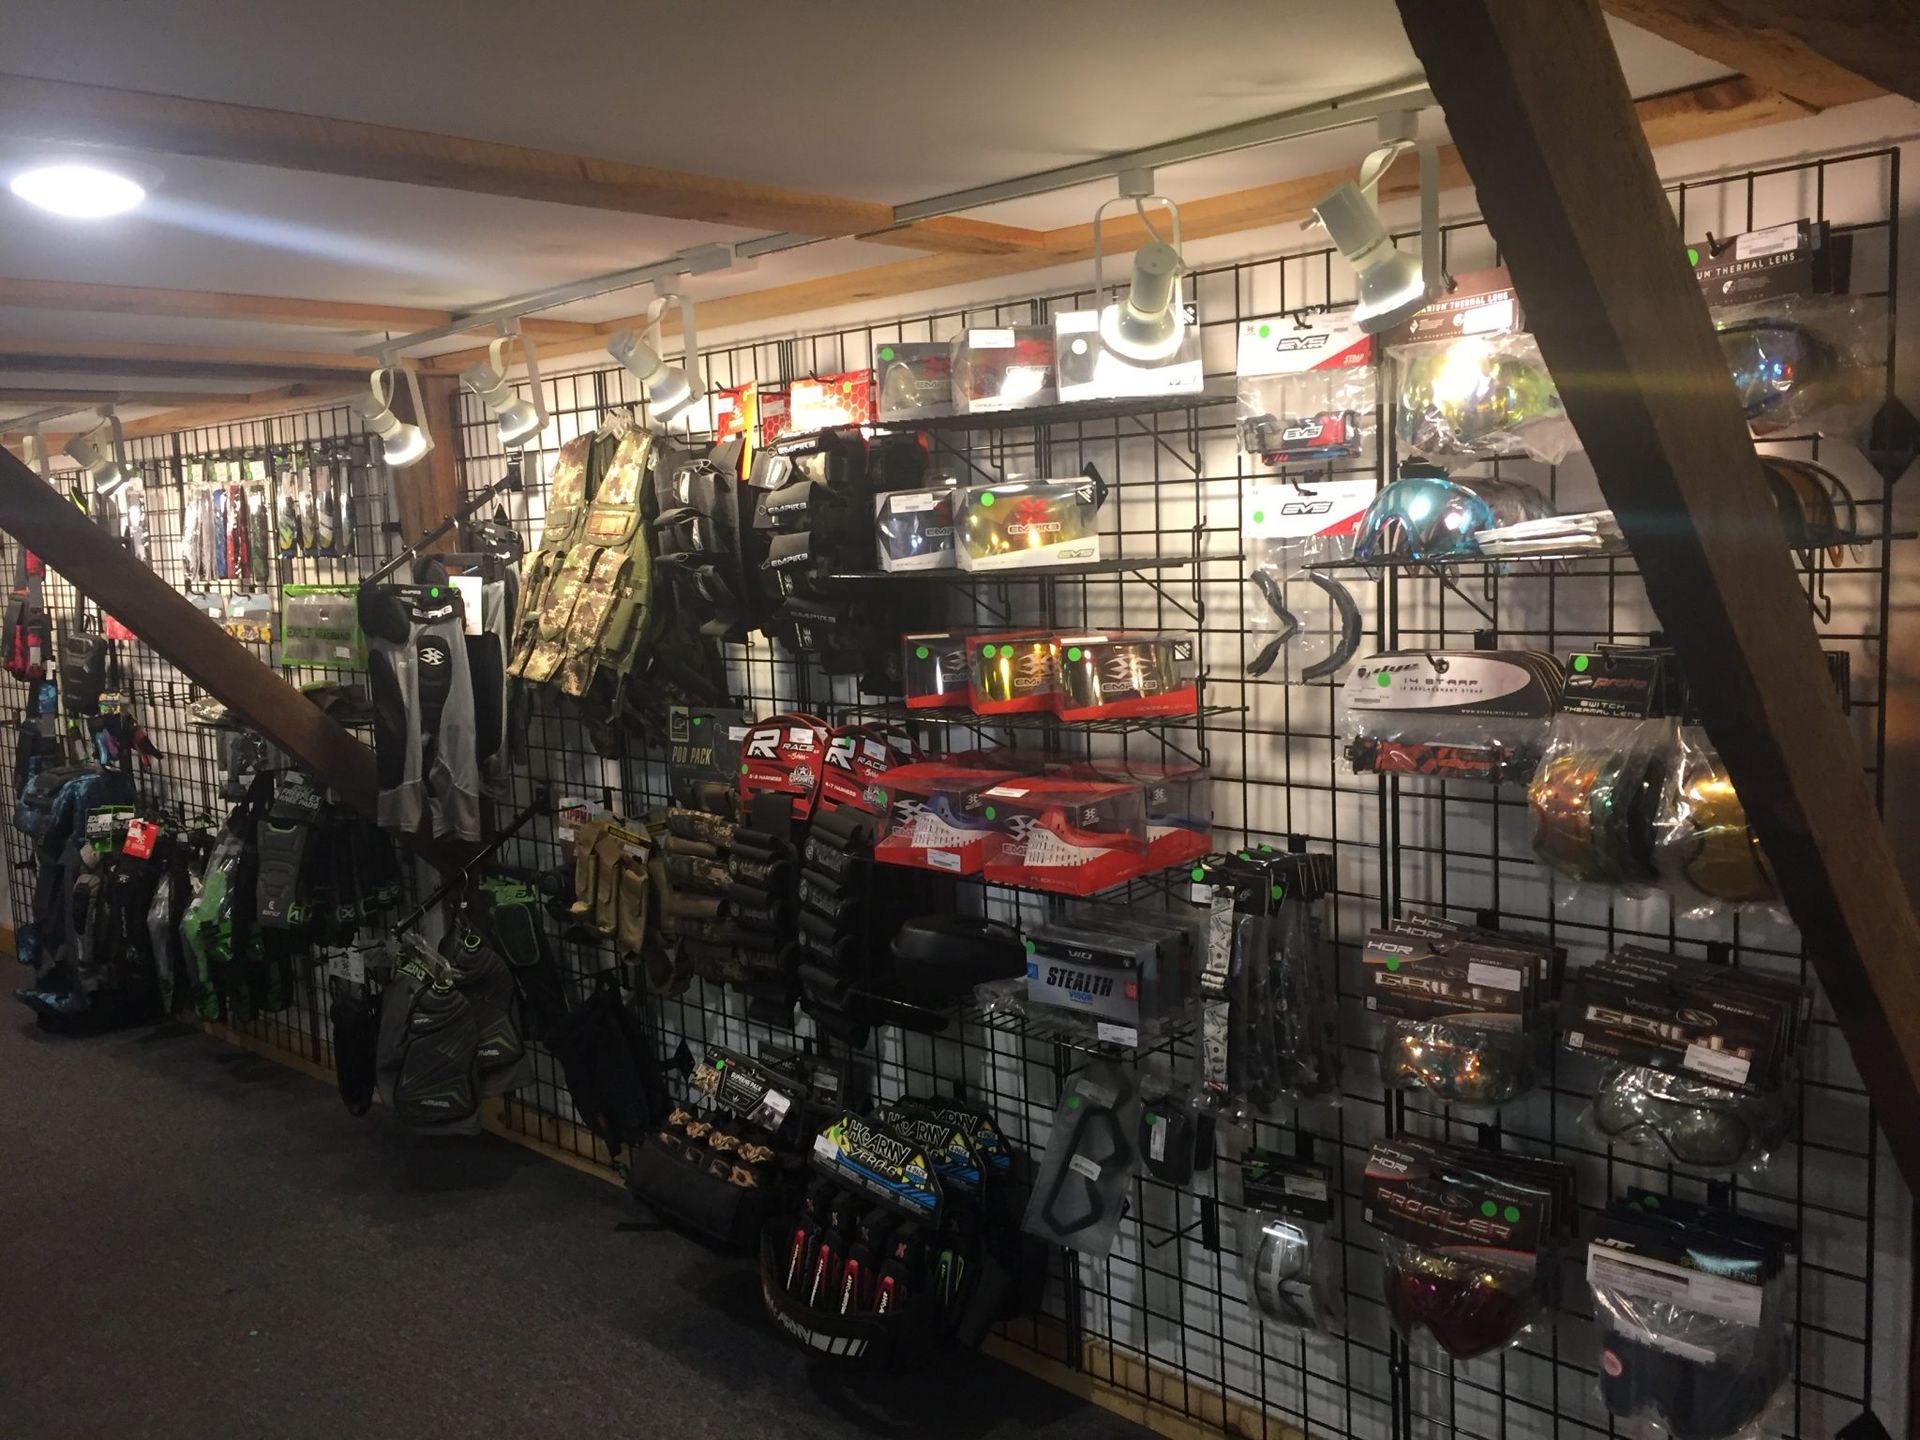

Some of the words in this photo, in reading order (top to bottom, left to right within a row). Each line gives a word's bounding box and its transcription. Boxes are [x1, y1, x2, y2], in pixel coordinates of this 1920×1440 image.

[1716, 260, 1764, 276] THERMAL
[1769, 252, 1796, 266] LENS
[1276, 333, 1330, 352] EVS
[1282, 424, 1324, 441] EVS
[767, 501, 808, 516] EMPIRE
[1281, 501, 1334, 516] EVS
[771, 552, 809, 568] EMPIRE
[1580, 699, 1626, 711] SWITCH
[782, 742, 815, 753] RACE
[672, 745, 688, 764] POD
[689, 746, 713, 767] PACK
[856, 756, 888, 772] RACE
[1067, 949, 1094, 961] VIO
[1367, 940, 1414, 956] HDR
[1046, 966, 1114, 998] STEALTH
[1370, 1154, 1408, 1174] HDR
[1377, 1186, 1512, 1240] PROFILER
